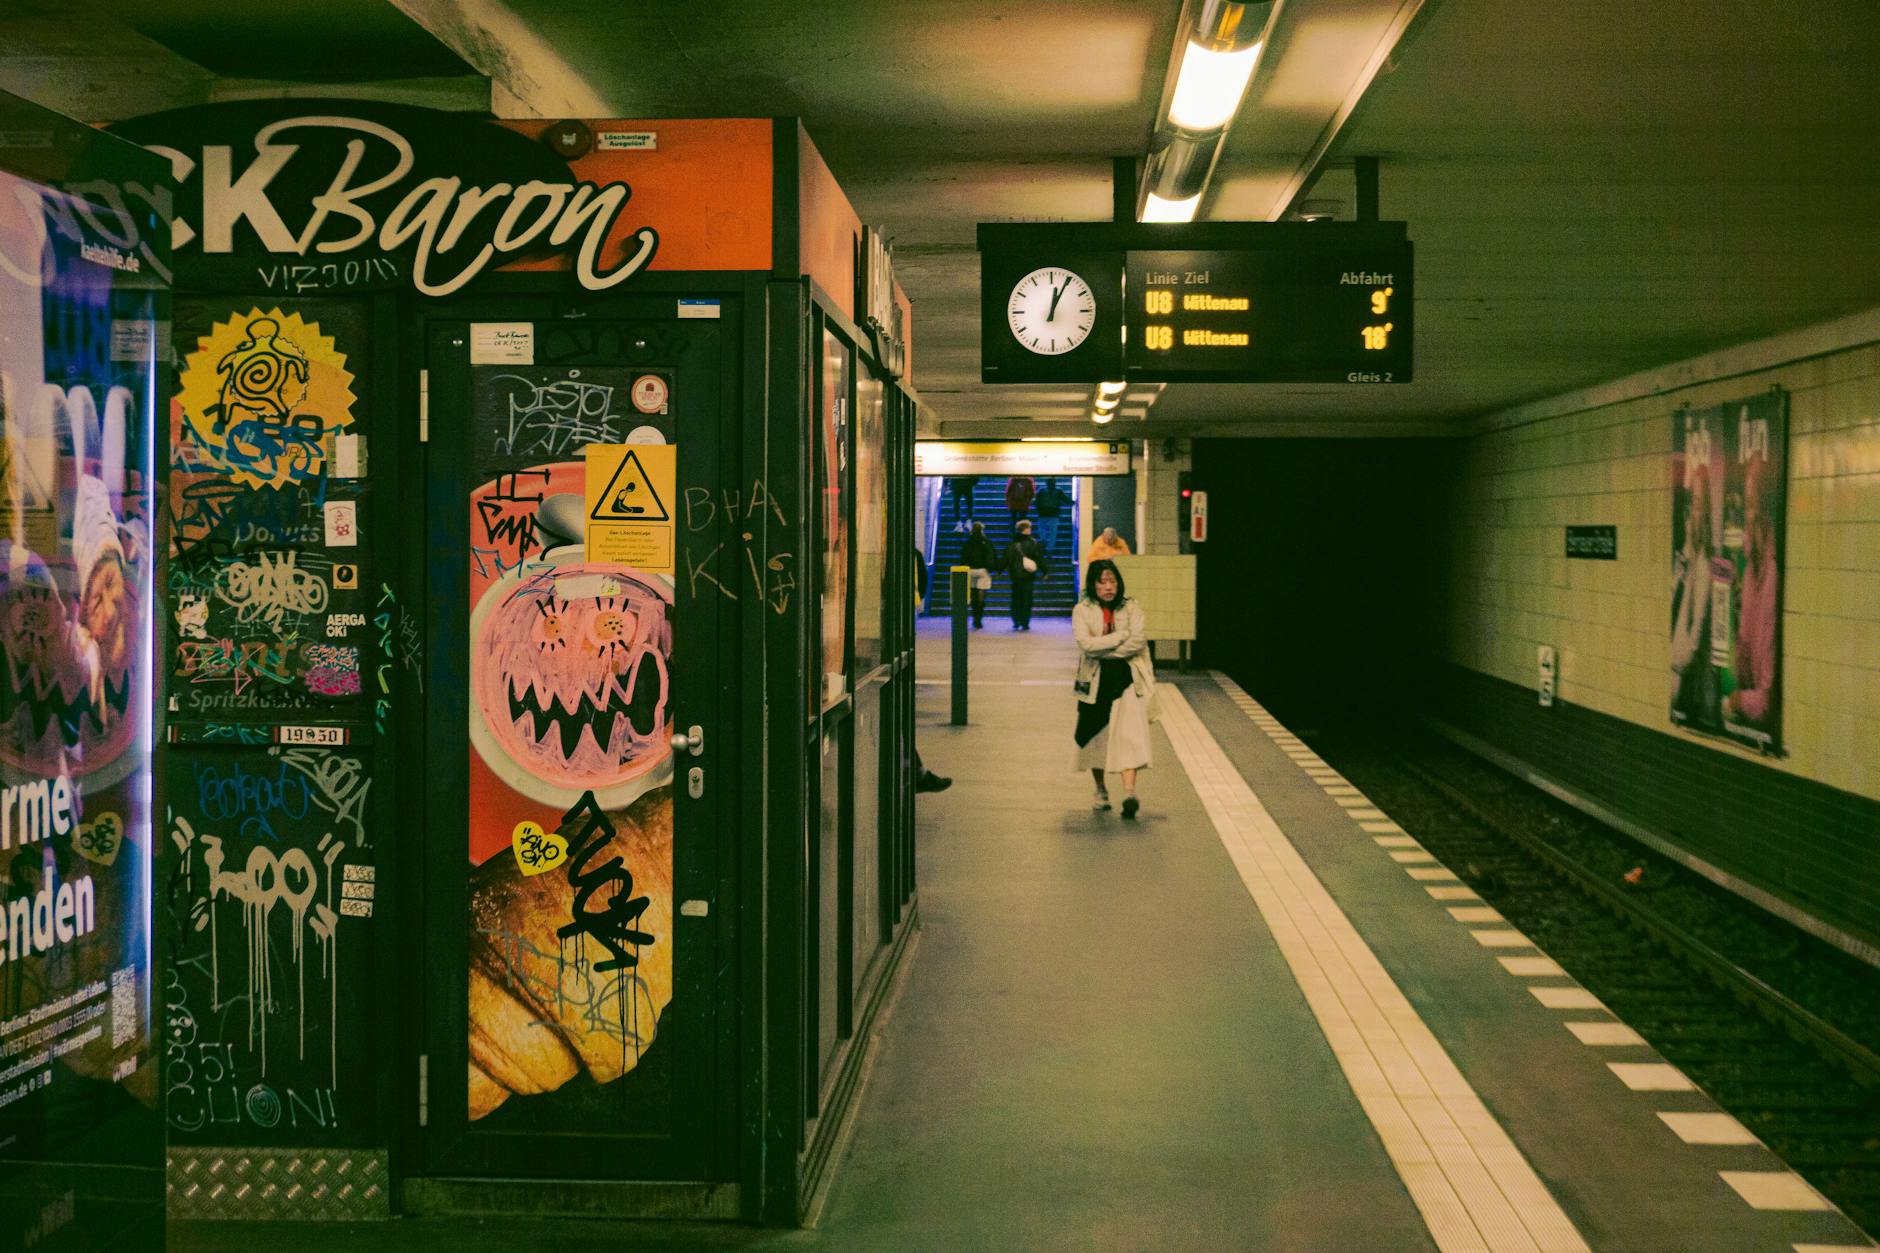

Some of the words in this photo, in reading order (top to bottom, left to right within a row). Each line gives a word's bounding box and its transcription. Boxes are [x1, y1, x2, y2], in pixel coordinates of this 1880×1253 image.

[254, 115, 656, 298] Baron
[1146, 272, 1179, 285] Linie
[1184, 271, 1209, 284] Ziel
[1340, 271, 1394, 285] Abfahrt
[1145, 291, 1173, 314] U8
[1145, 326, 1173, 350] U8
[1347, 372, 1381, 383] Gleis
[1384, 372, 1393, 383] 2
[326, 614, 366, 626] AERGA
